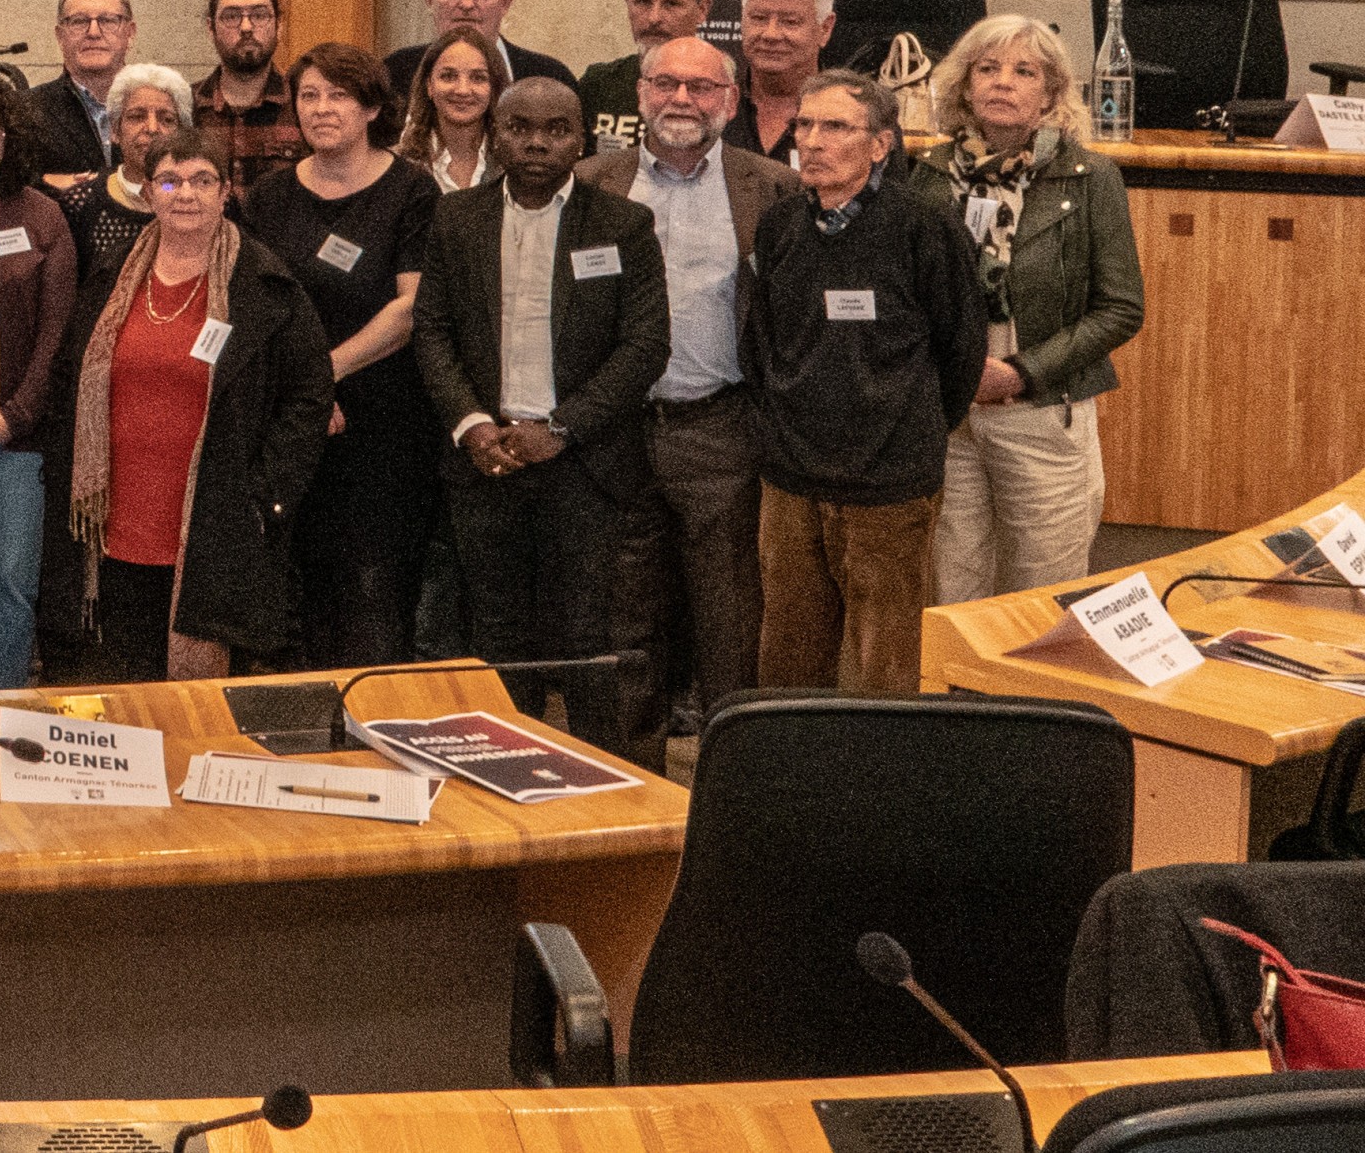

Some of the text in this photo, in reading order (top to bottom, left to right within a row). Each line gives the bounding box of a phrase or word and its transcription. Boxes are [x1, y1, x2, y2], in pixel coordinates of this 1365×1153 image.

[1085, 585, 1149, 625] Emmanuelle
[1113, 612, 1152, 641] ABADIE
[49, 725, 118, 749] Daniel
[14, 771, 51, 783] Canton
